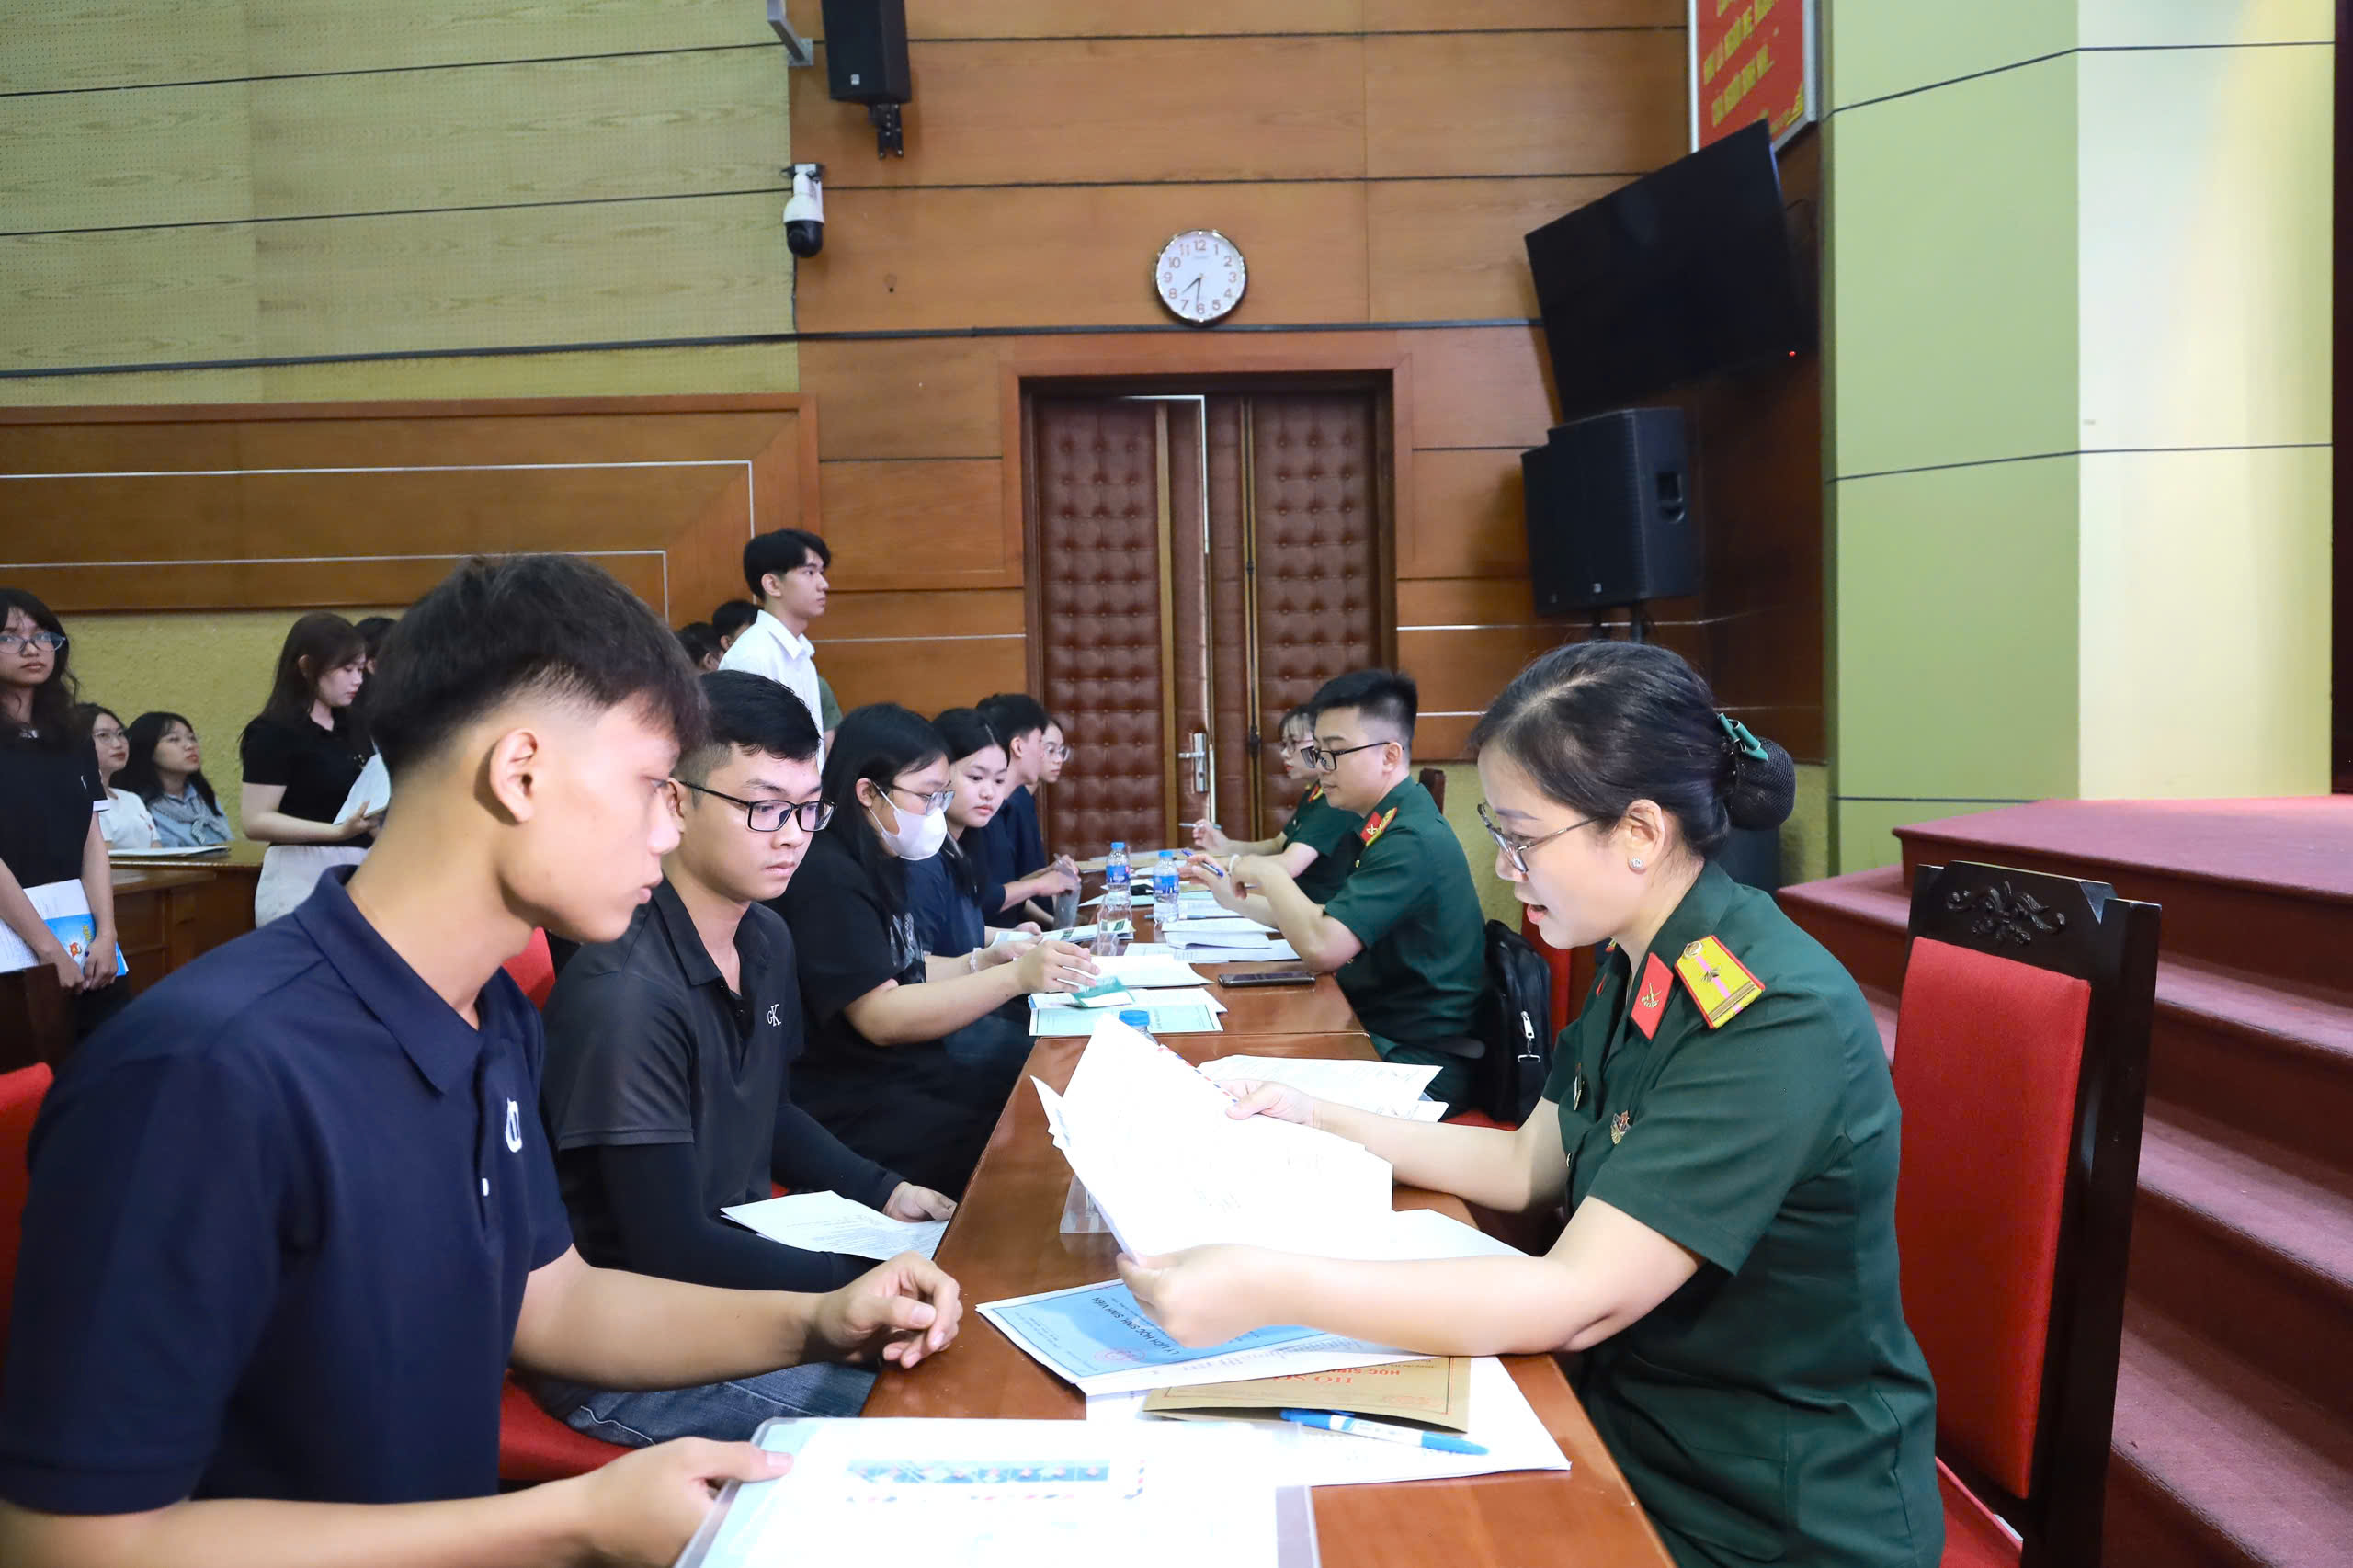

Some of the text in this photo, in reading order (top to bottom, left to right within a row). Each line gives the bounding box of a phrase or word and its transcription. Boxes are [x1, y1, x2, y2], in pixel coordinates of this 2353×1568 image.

[1179, 244, 1190, 256] 11
[1194, 240, 1207, 251] 12
[1214, 244, 1219, 255] 1
[1168, 256, 1181, 268] 10
[1224, 256, 1232, 267] 2
[1163, 273, 1172, 283] 9
[1229, 273, 1236, 283] 3
[1169, 288, 1176, 299] 8
[1224, 288, 1232, 298] 4
[1180, 299, 1189, 311] 7
[1197, 303, 1205, 315] 6
[1212, 299, 1221, 311] 5
[1120, 1318, 1141, 1330] SINH
